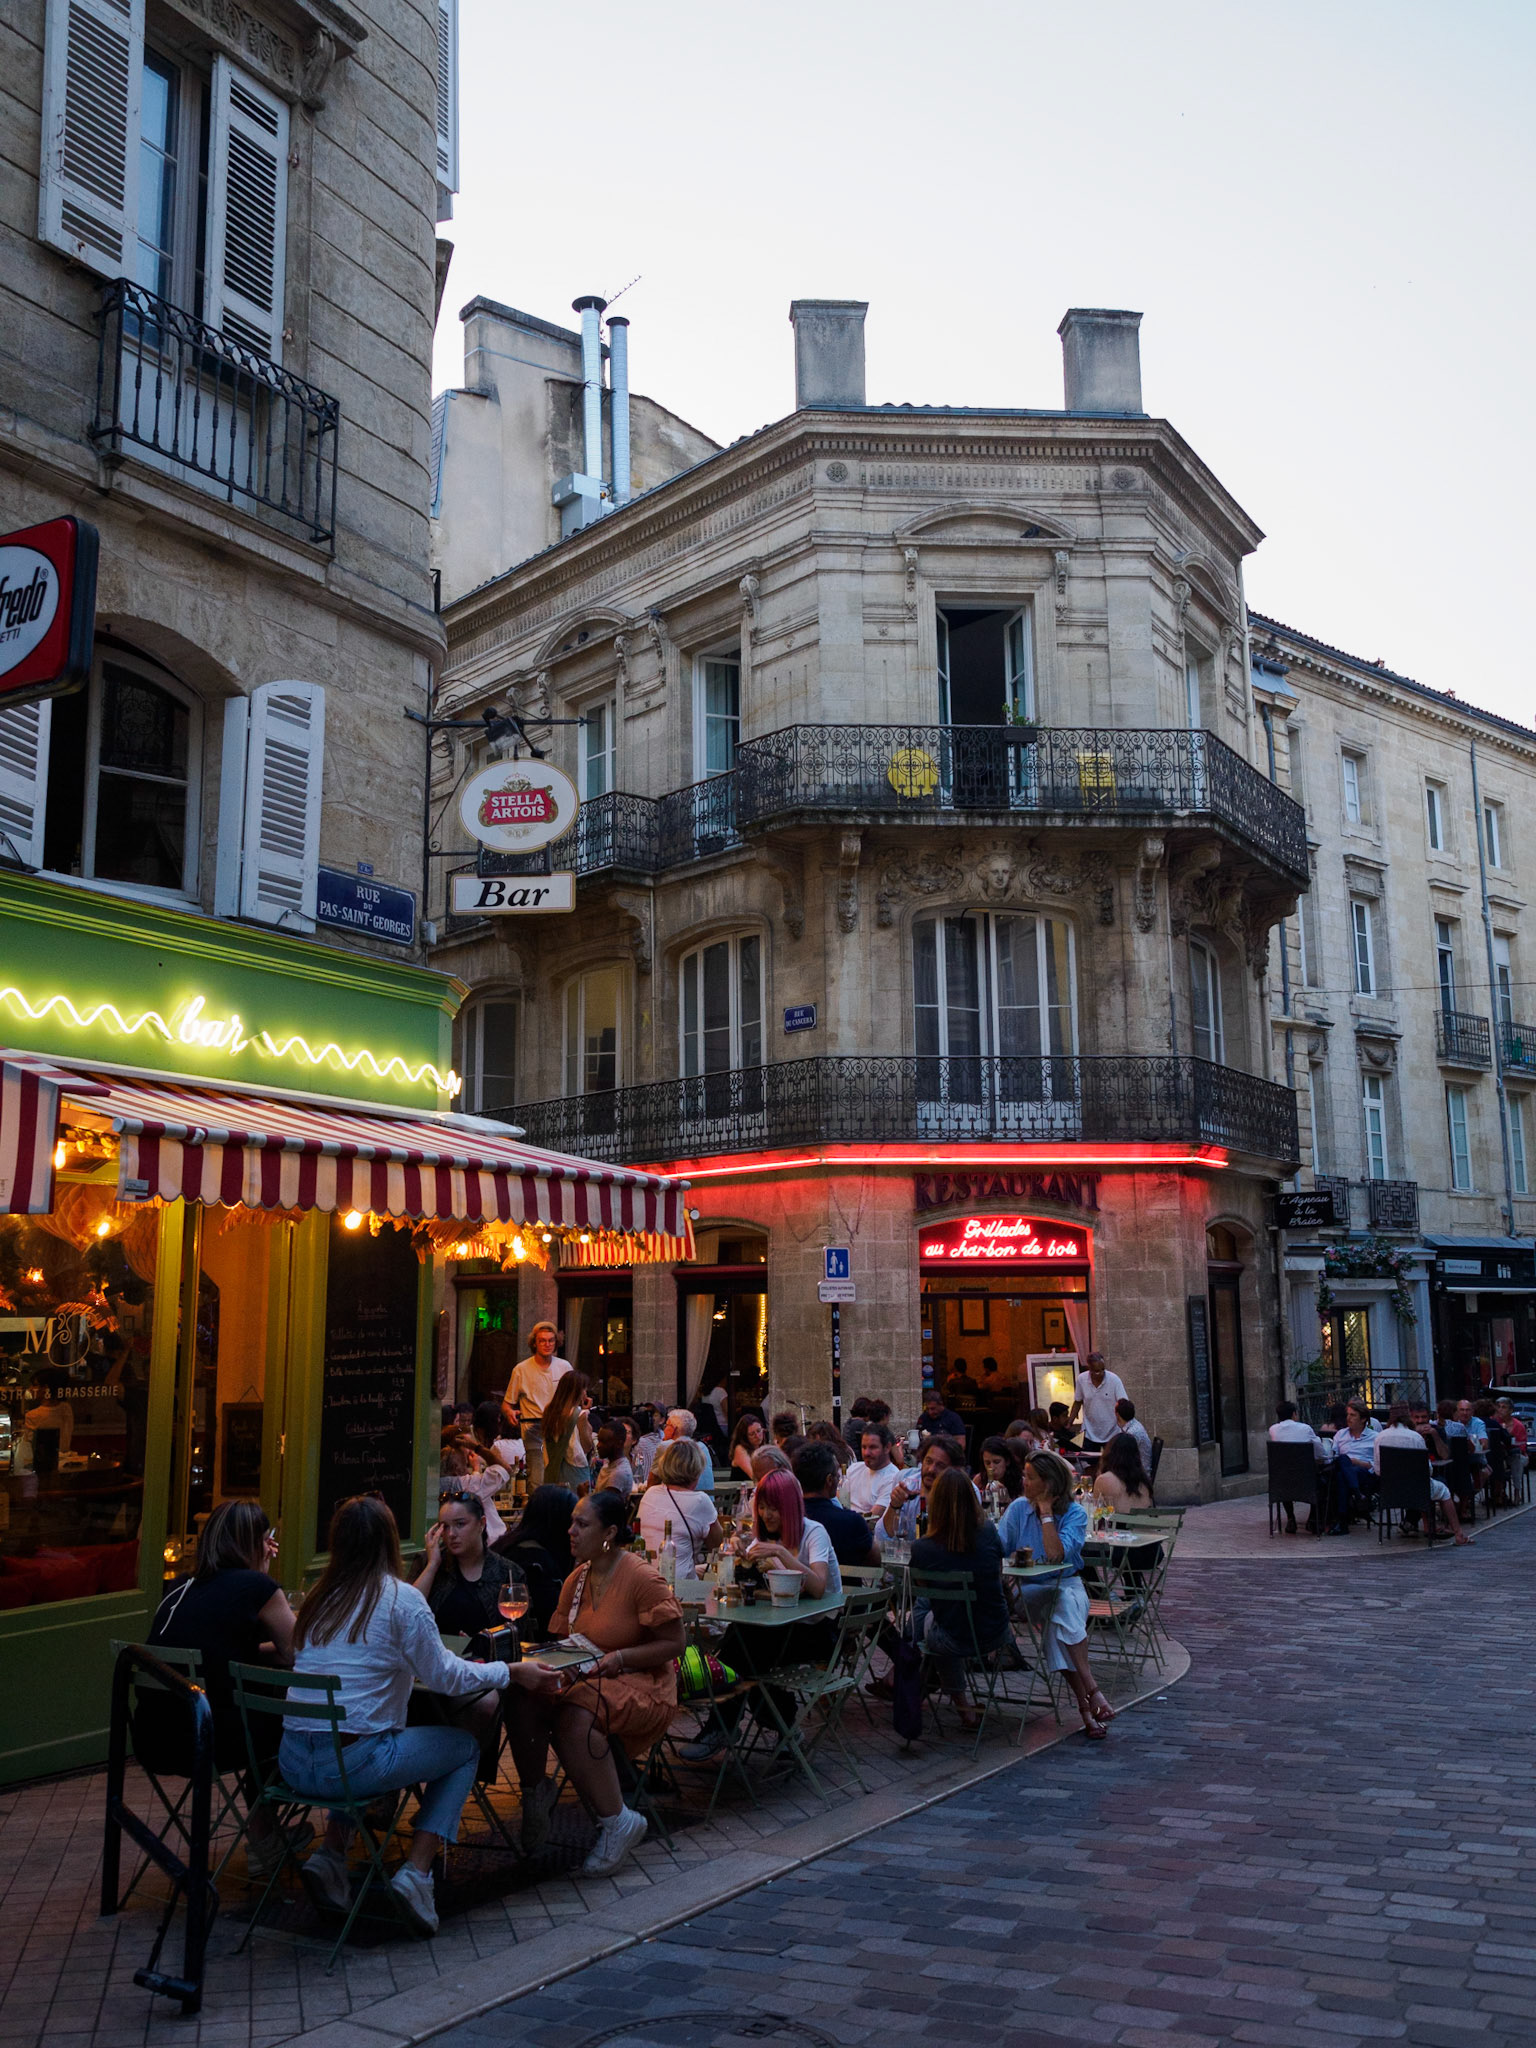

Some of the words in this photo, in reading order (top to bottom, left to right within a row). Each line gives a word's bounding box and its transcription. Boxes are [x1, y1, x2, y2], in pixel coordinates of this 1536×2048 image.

[491, 794, 545, 808] STELLA
[491, 805, 545, 819] ARTOIS
[356, 885, 381, 903] RUE
[473, 880, 550, 907] Bar
[363, 902, 373, 911] DU
[319, 901, 411, 937] PAS-SAINT-GEORGES
[179, 995, 249, 1057] bar
[914, 1171, 1101, 1211] RESTAURANT
[1280, 1196, 1330, 1207] L'Agneau
[1304, 1205, 1318, 1215] la
[964, 1218, 1031, 1239] Grillades
[1289, 1217, 1325, 1226] Braise
[925, 1244, 944, 1256] au
[950, 1240, 1017, 1257] charbon
[1021, 1238, 1043, 1255] de
[1047, 1240, 1078, 1256] bois
[44, 1389, 51, 1399] &
[57, 1386, 119, 1399] BRASSERIE
